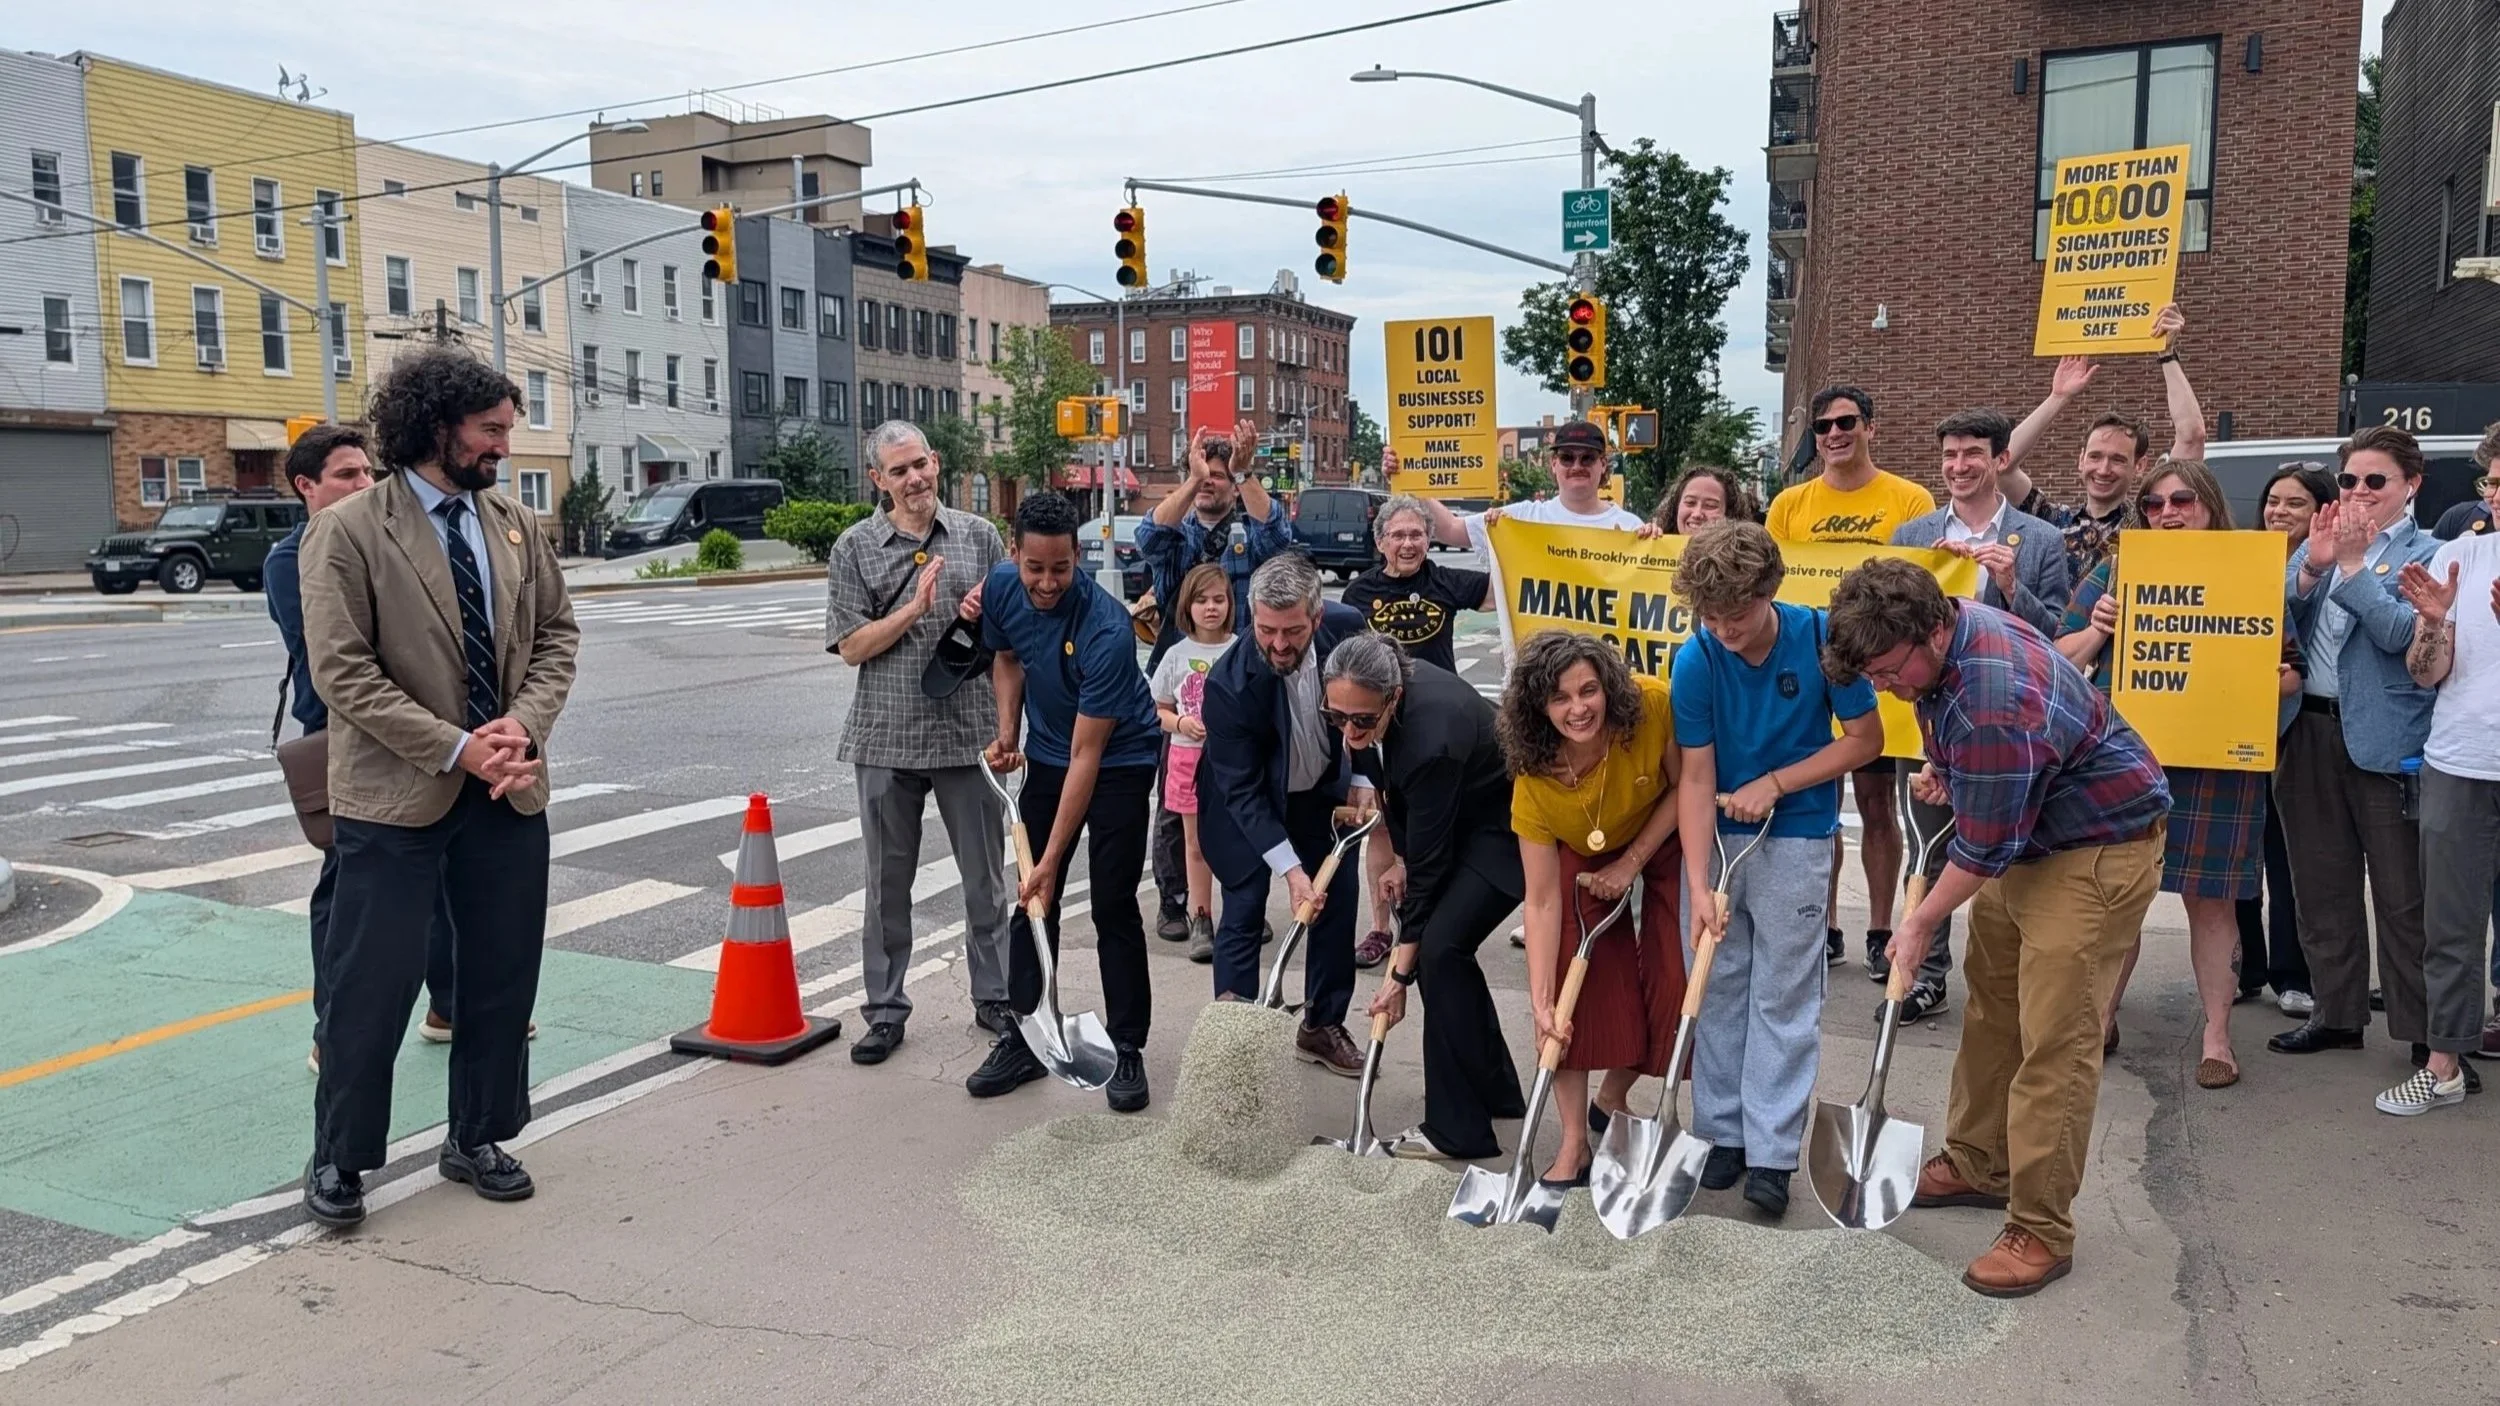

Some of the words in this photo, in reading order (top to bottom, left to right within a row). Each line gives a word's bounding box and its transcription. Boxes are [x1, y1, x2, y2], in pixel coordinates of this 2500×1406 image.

[2064, 162, 2119, 185] MORE
[2125, 156, 2178, 178] THAN
[2055, 181, 2171, 226] 10,000
[1565, 218, 1608, 229] Waterfront
[2056, 227, 2170, 253] SIGNATURES
[2054, 255, 2073, 273] IN
[2077, 249, 2167, 272] SUPPORT!
[2084, 286, 2125, 301] MAKE
[2056, 302, 2150, 320] McGUINNESS
[1193, 327, 1213, 336] Who
[2083, 322, 2118, 337] SAFE
[1193, 338, 1211, 347] said
[1415, 325, 1463, 362] 101
[1193, 350, 1227, 359] revenue
[1193, 360, 1221, 369] should
[1417, 369, 1461, 384] LOCAL
[1399, 390, 1484, 407] BUSINESSES
[1408, 413, 1475, 429] SUPPORT!
[2383, 406, 2432, 430] 216
[1425, 440, 1460, 453] MAKE
[1404, 455, 1483, 470] McGUINNESS
[1429, 473, 1458, 485] SAFE
[1811, 515, 1882, 533] CRASH
[1547, 544, 1577, 558] North
[1581, 550, 1637, 566] Brooklyn
[1784, 564, 1816, 577] nsive
[1820, 566, 1843, 578] red
[2136, 584, 2205, 606] MAKE
[1518, 577, 1618, 626] MAKE
[1629, 591, 1700, 633] Mc
[1379, 619, 1438, 638] STREETS
[2134, 614, 2274, 636] McGUINNESS
[2132, 640, 2191, 663] SAFE
[2131, 670, 2188, 692] NOW
